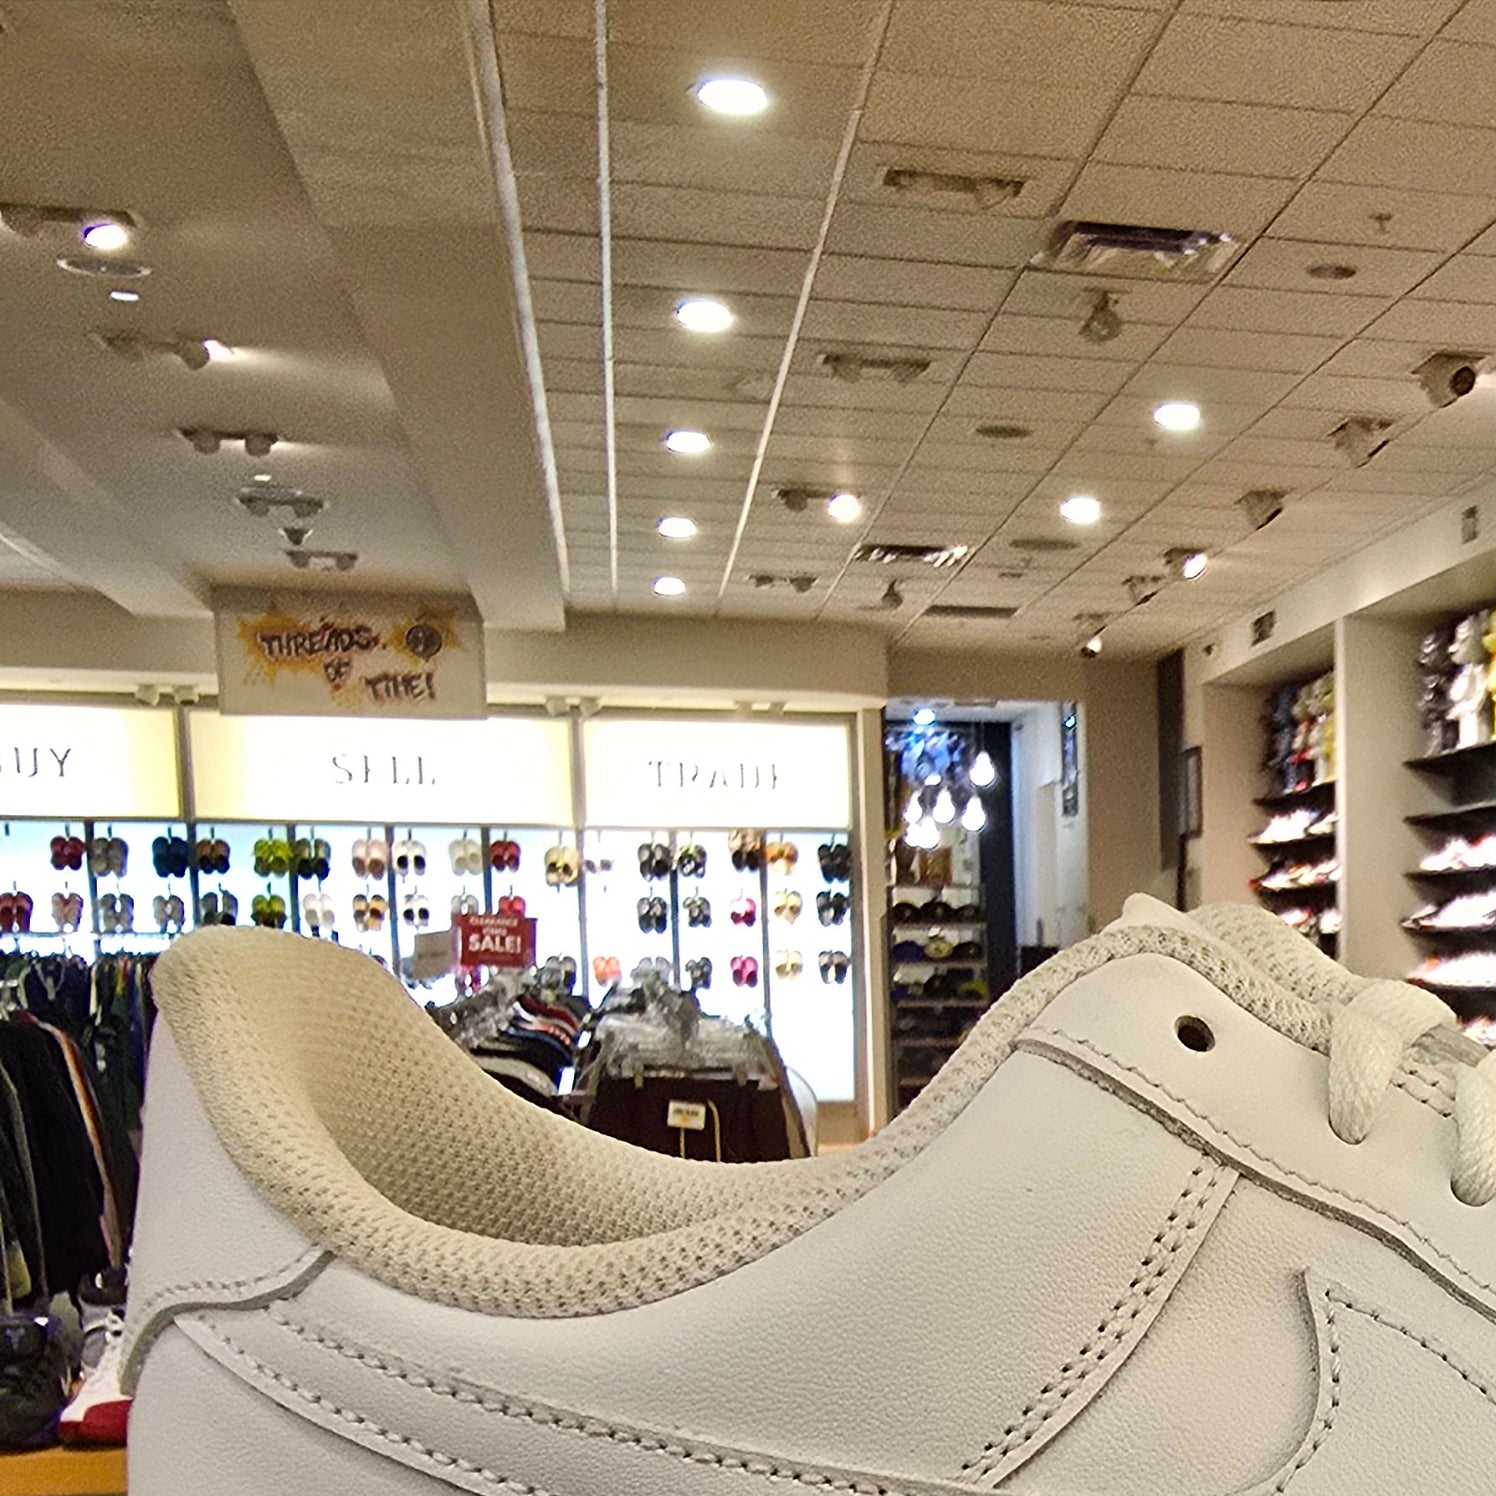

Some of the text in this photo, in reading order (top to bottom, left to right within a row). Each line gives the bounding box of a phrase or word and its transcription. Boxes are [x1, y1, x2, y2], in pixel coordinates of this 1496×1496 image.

[323, 658, 350, 682] OF
[0, 747, 71, 777] UY
[331, 754, 436, 785] SELL
[648, 760, 780, 790] TRADE
[468, 934, 522, 953] SALE!
